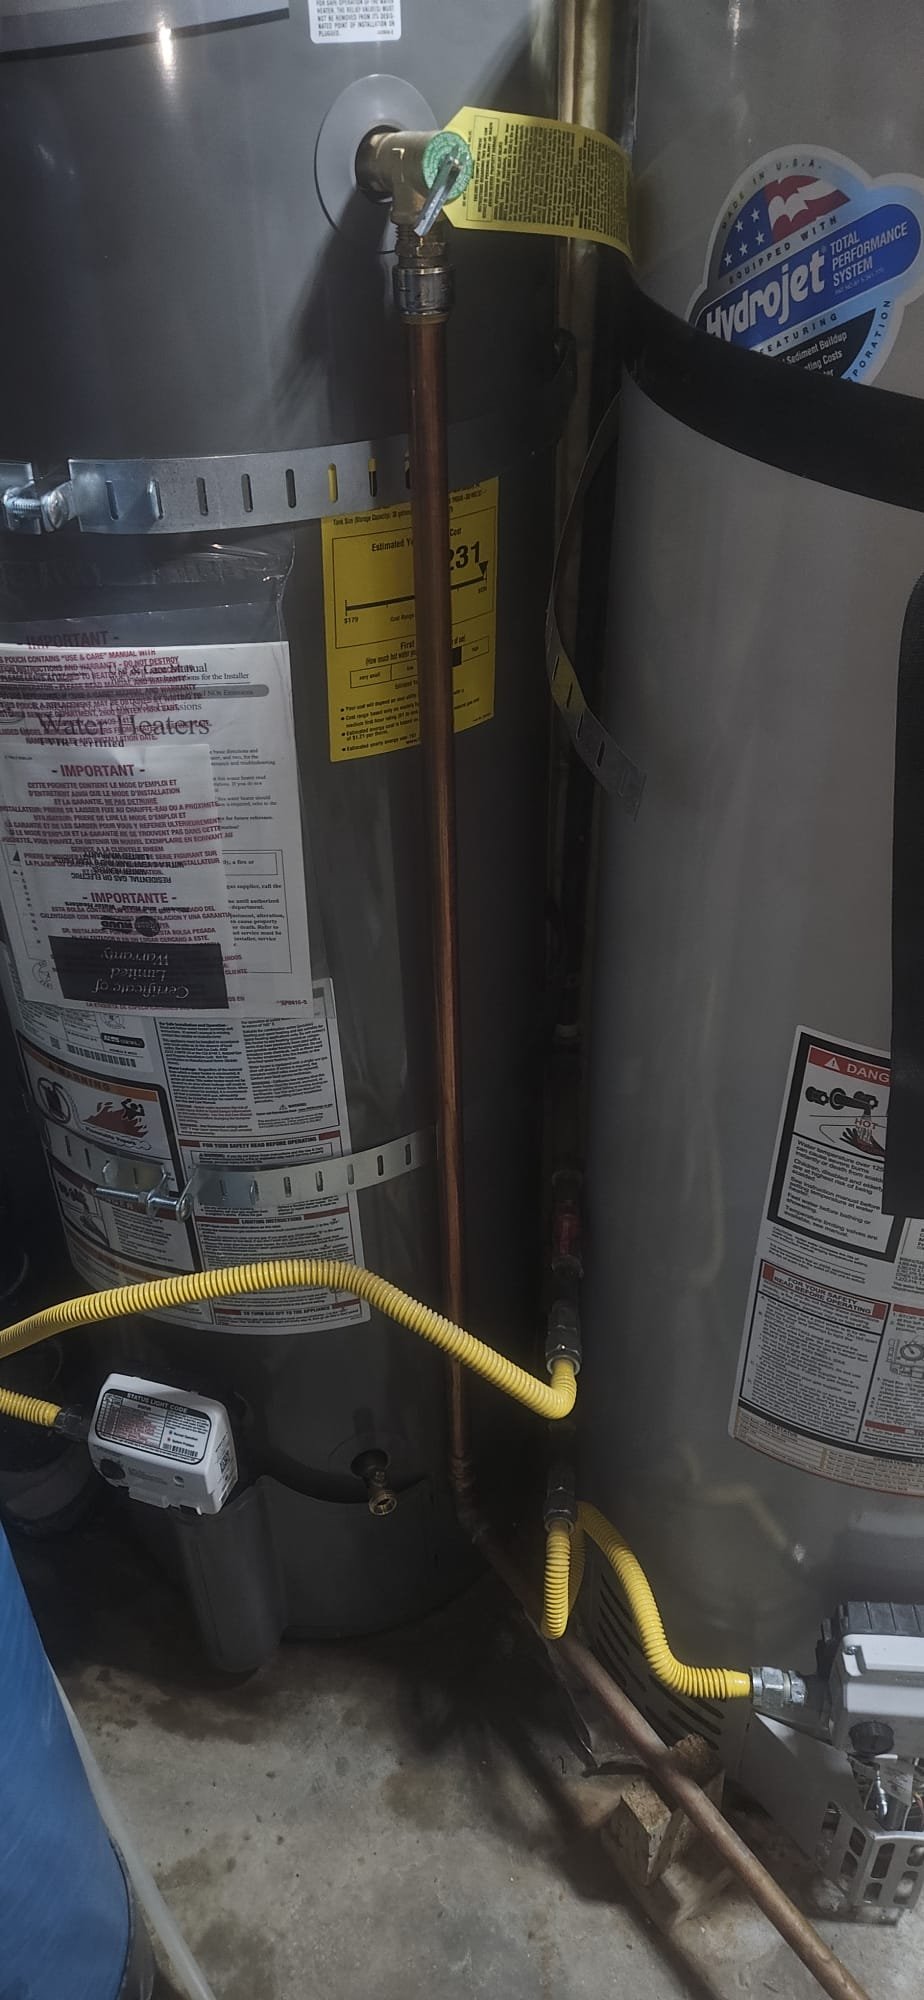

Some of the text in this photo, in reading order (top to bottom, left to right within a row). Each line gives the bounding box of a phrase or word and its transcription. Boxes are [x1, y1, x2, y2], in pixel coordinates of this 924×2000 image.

[721, 158, 823, 229] MADE IN U.S.A.
[728, 215, 838, 284] EQUIPPED WITH
[830, 230, 861, 255] TOTAL
[831, 222, 909, 271] PERFORMANCE
[832, 256, 873, 287] SYSTEM
[706, 250, 825, 342] Hydrojet
[786, 330, 848, 365] Sediment Buildup
[823, 348, 843, 365] Costs
[371, 540, 405, 552] Estimated
[108, 651, 137, 659] MANUAL
[400, 639, 415, 650] First
[201, 671, 250, 681] for the Installer
[38, 714, 211, 738] Water Heaters
[60, 764, 135, 777] IMPORTANT
[71, 871, 172, 884] RESIDENTIAL GAS OR ELECTRIC
[90, 892, 169, 904] IMPORTANTE
[101, 946, 169, 967] Warranty
[110, 967, 167, 982] Limited
[92, 982, 190, 1000] Certificate of
[854, 1118, 878, 1130] HOT
[229, 1141, 250, 1149] SAFETY
[797, 1141, 871, 1168] Water temperature over
[793, 1158, 821, 1173] Children,
[821, 1169, 849, 1181] disabled
[849, 1178, 862, 1186] and
[795, 1151, 820, 1165] instantly
[829, 1162, 848, 1173] death
[848, 1168, 864, 1178] from
[808, 1150, 828, 1161] cause
[828, 1157, 850, 1168] severe
[850, 1164, 870, 1174] burns
[790, 1176, 881, 1211] See instruction manual before
[810, 1170, 834, 1183] highest
[834, 1178, 846, 1187] risk
[855, 1186, 873, 1196] being
[801, 1198, 819, 1208] water
[818, 1204, 839, 1216] before
[839, 1211, 864, 1225] bathing
[810, 1189, 847, 1206] temperature
[855, 1204, 874, 1213] water
[785, 1205, 823, 1223] Temperature
[845, 1228, 867, 1239] valves
[812, 1222, 824, 1230] see
[824, 1226, 849, 1239] manual.
[774, 1276, 871, 1314] READ BEFORE OPERATING
[787, 1277, 858, 1305] FOR YOUR SAFETY
[126, 1393, 187, 1413] STATUS LIGHT CODE
